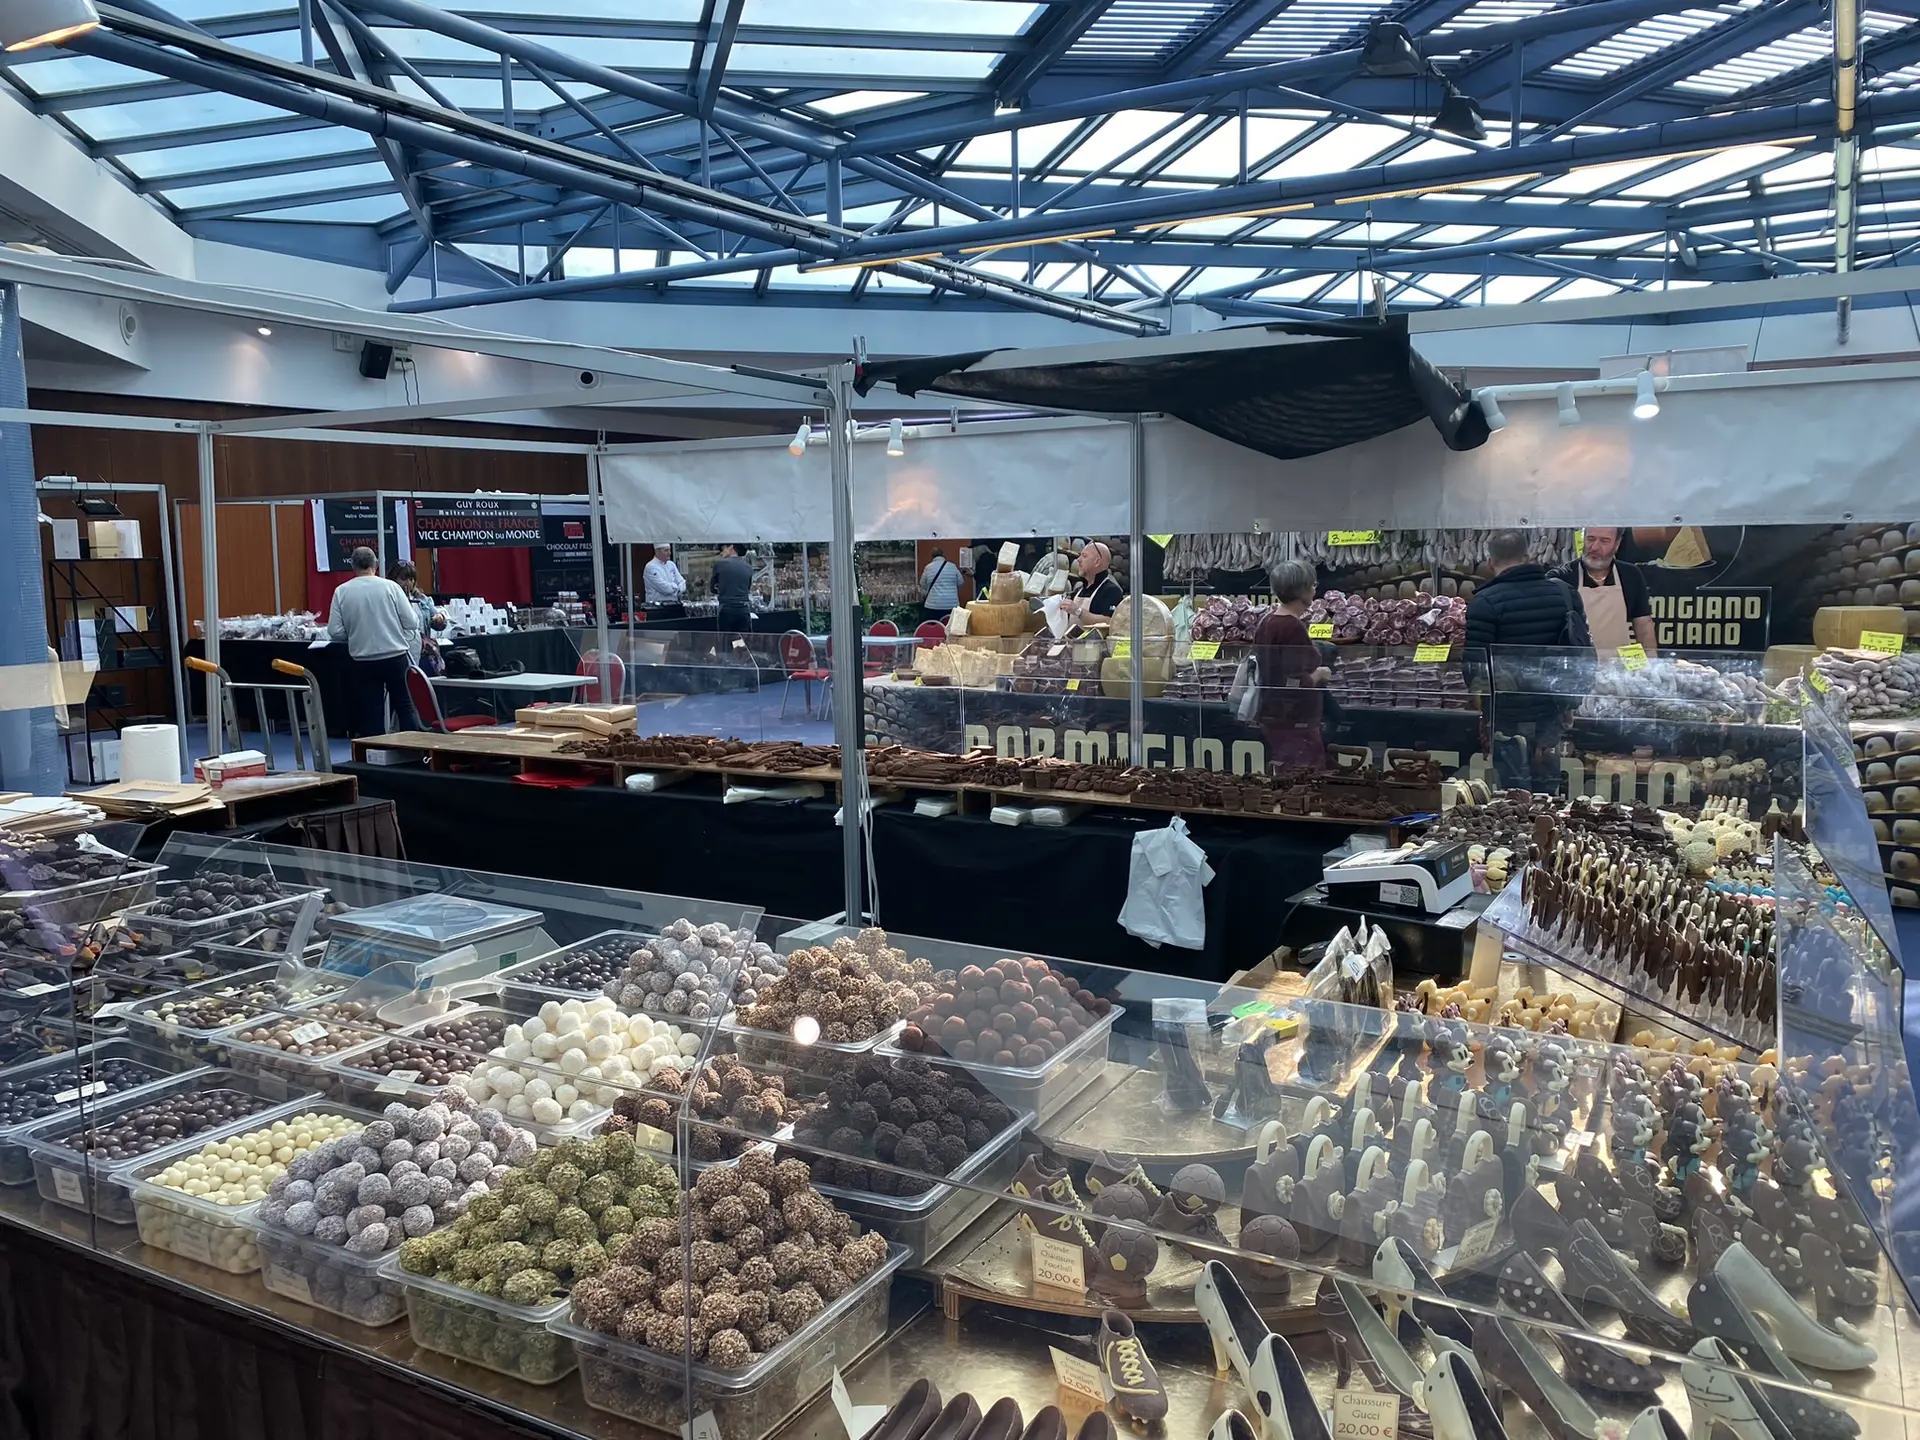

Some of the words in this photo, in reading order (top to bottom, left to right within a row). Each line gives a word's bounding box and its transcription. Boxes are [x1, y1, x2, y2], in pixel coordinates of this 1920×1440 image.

[456, 501, 473, 509] GUY
[475, 501, 499, 509] ROUX
[416, 518, 481, 529] CHAMPION
[498, 518, 540, 529] FRANCE
[418, 530, 440, 540] VICE
[441, 530, 494, 540] CHAMPION
[505, 530, 541, 539] MONDE
[1342, 1393, 1393, 1408] Chaussure
[1352, 1409, 1381, 1421] Gucci
[1337, 1422, 1380, 1436] 20,00
[1383, 1426, 1393, 1438] €
